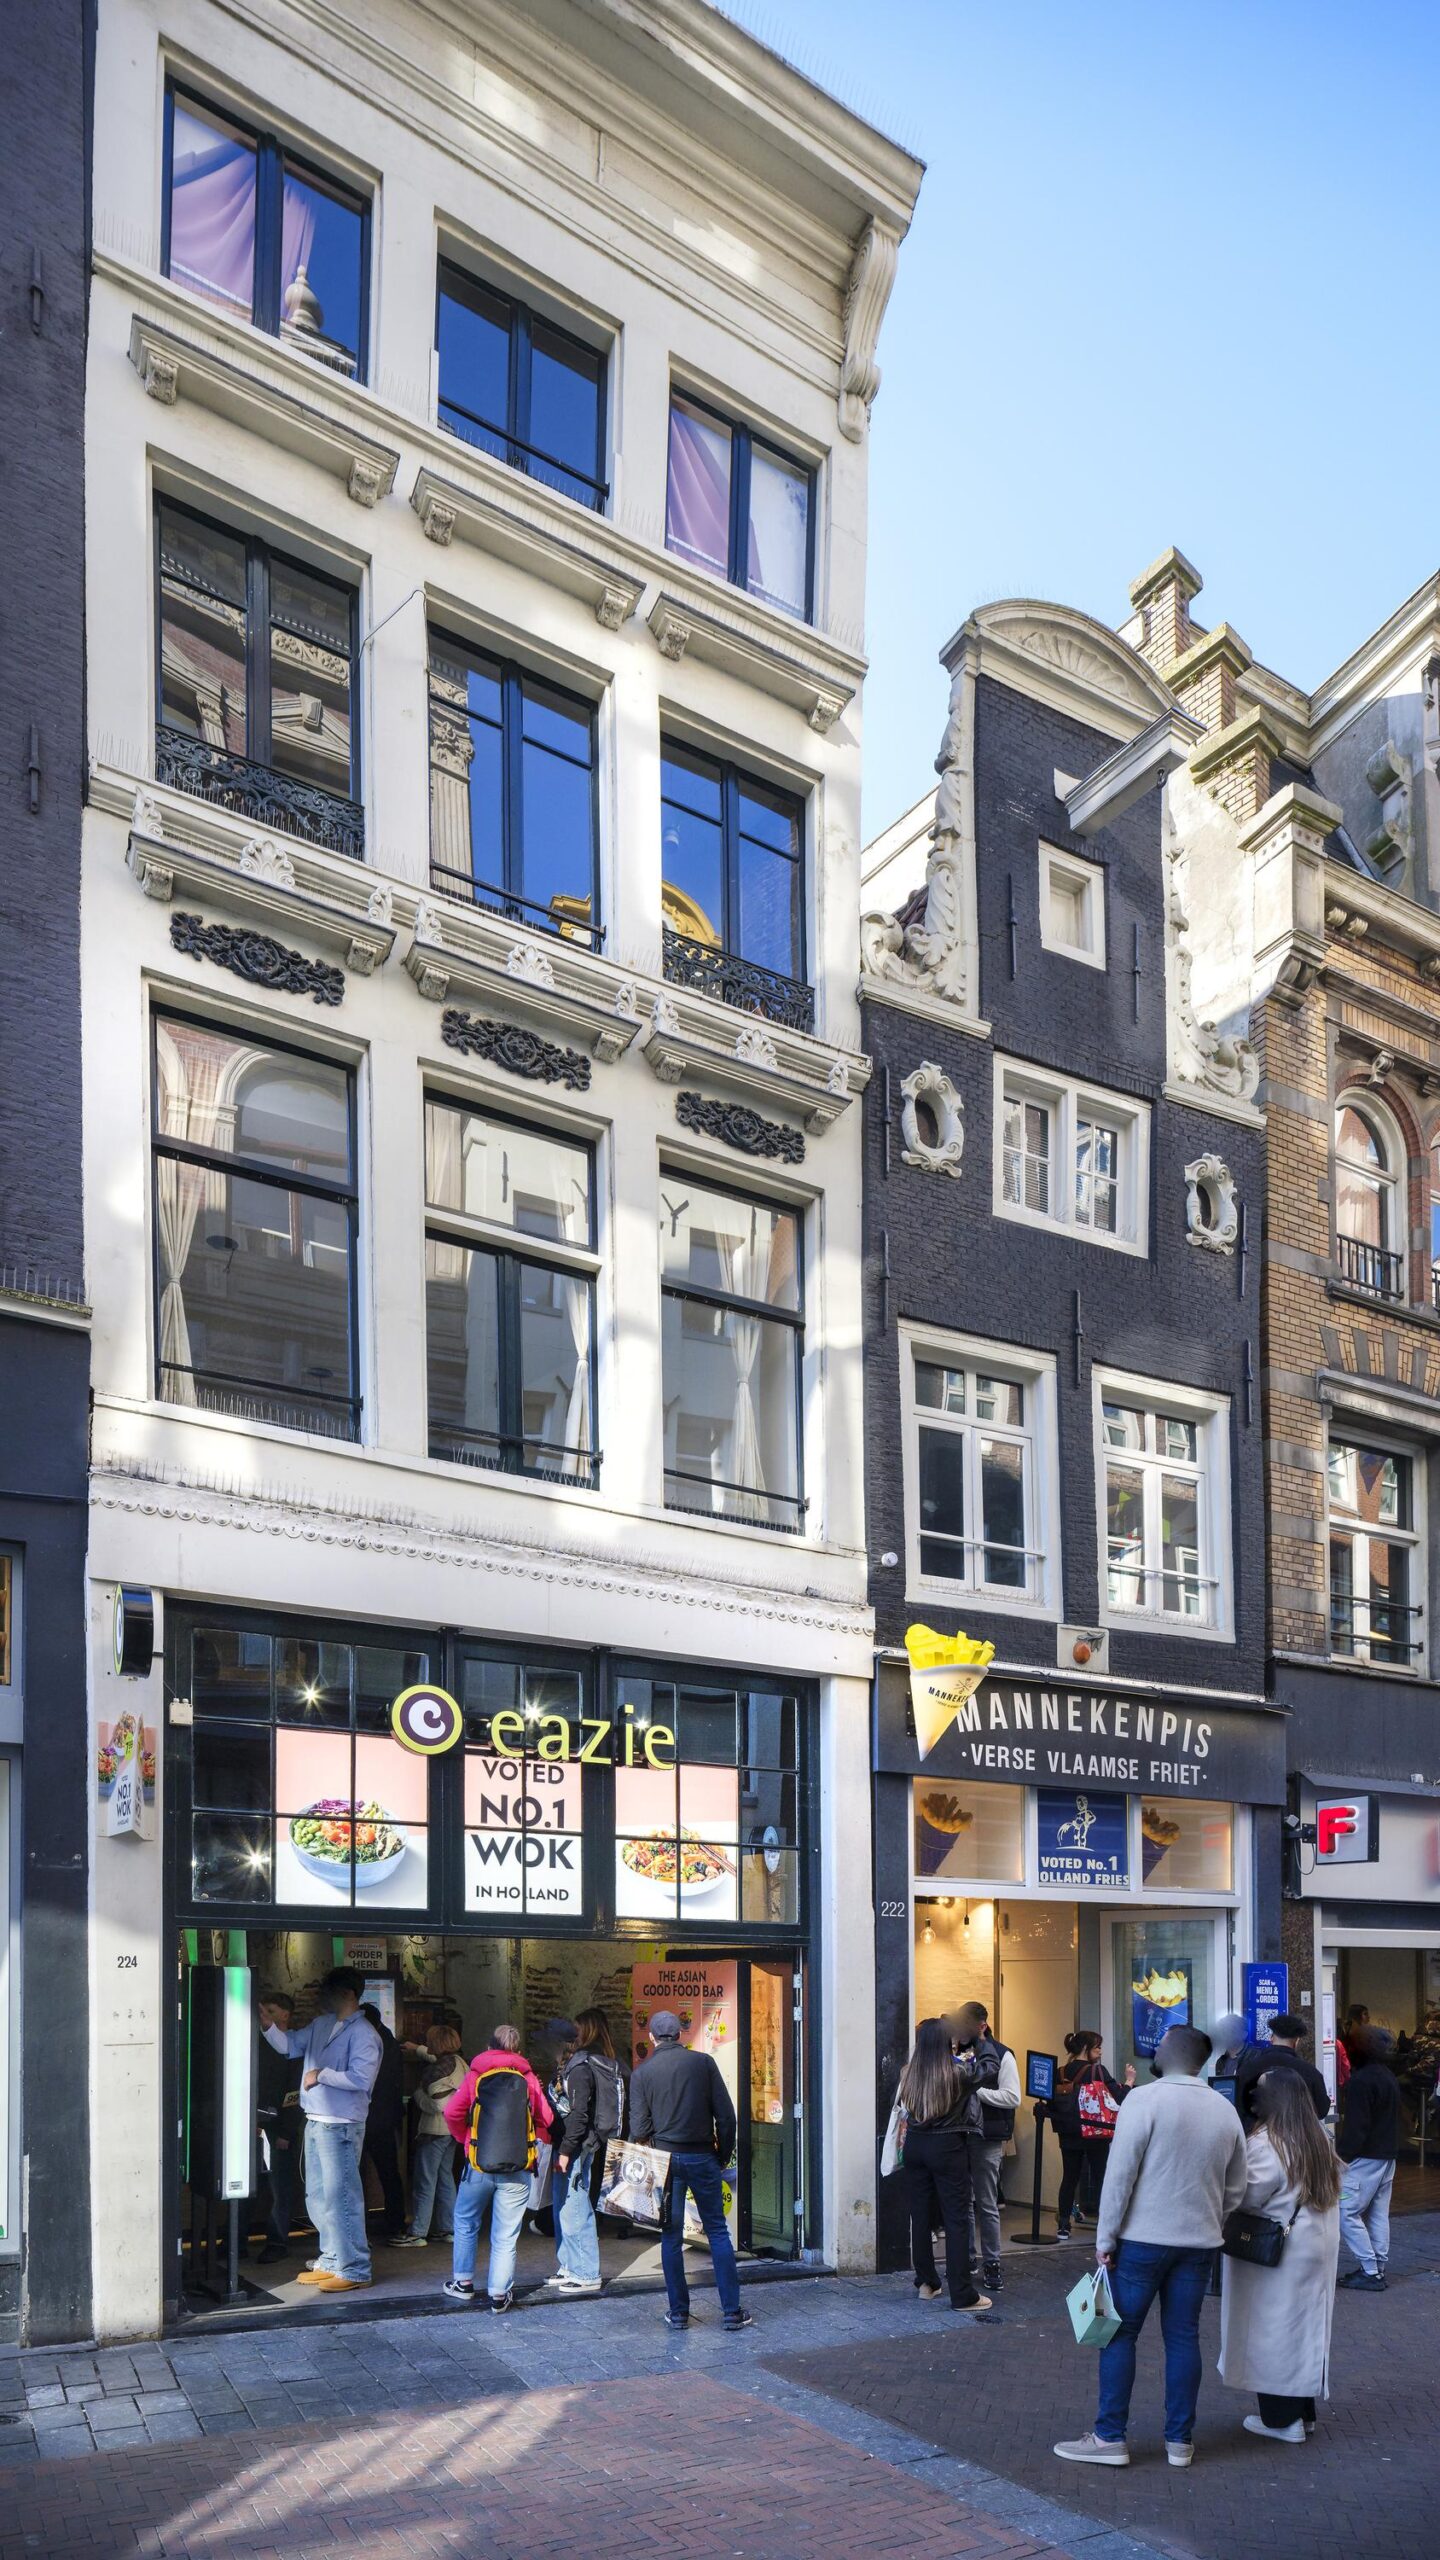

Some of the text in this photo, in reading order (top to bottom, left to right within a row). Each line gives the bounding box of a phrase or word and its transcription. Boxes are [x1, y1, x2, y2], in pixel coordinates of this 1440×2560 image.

[957, 1692, 1212, 1758] MANNEKENPIS
[490, 1704, 676, 1770] eazie
[971, 1743, 1201, 1786] VERSE VLAAMSE FRIET
[116, 1800, 132, 1817] WOK
[480, 1793, 565, 1829] NO.1
[1318, 1806, 1358, 1855] F
[470, 1834, 574, 1869] WOK
[1041, 1856, 1082, 1869] VOTED
[1095, 1873, 1129, 1886] FRIES
[476, 1885, 569, 1901] IN HOLAND
[881, 1901, 905, 1917] 222
[117, 1955, 138, 1968] 224
[348, 1950, 383, 1959] ORDER
[353, 1960, 379, 1968] HERE
[658, 1970, 707, 1982] THE ASIAN
[643, 1985, 724, 1997] GOOD FOOD BAR
[1256, 1986, 1279, 1995] MENU &
[1259, 1995, 1279, 2004] ORDER
